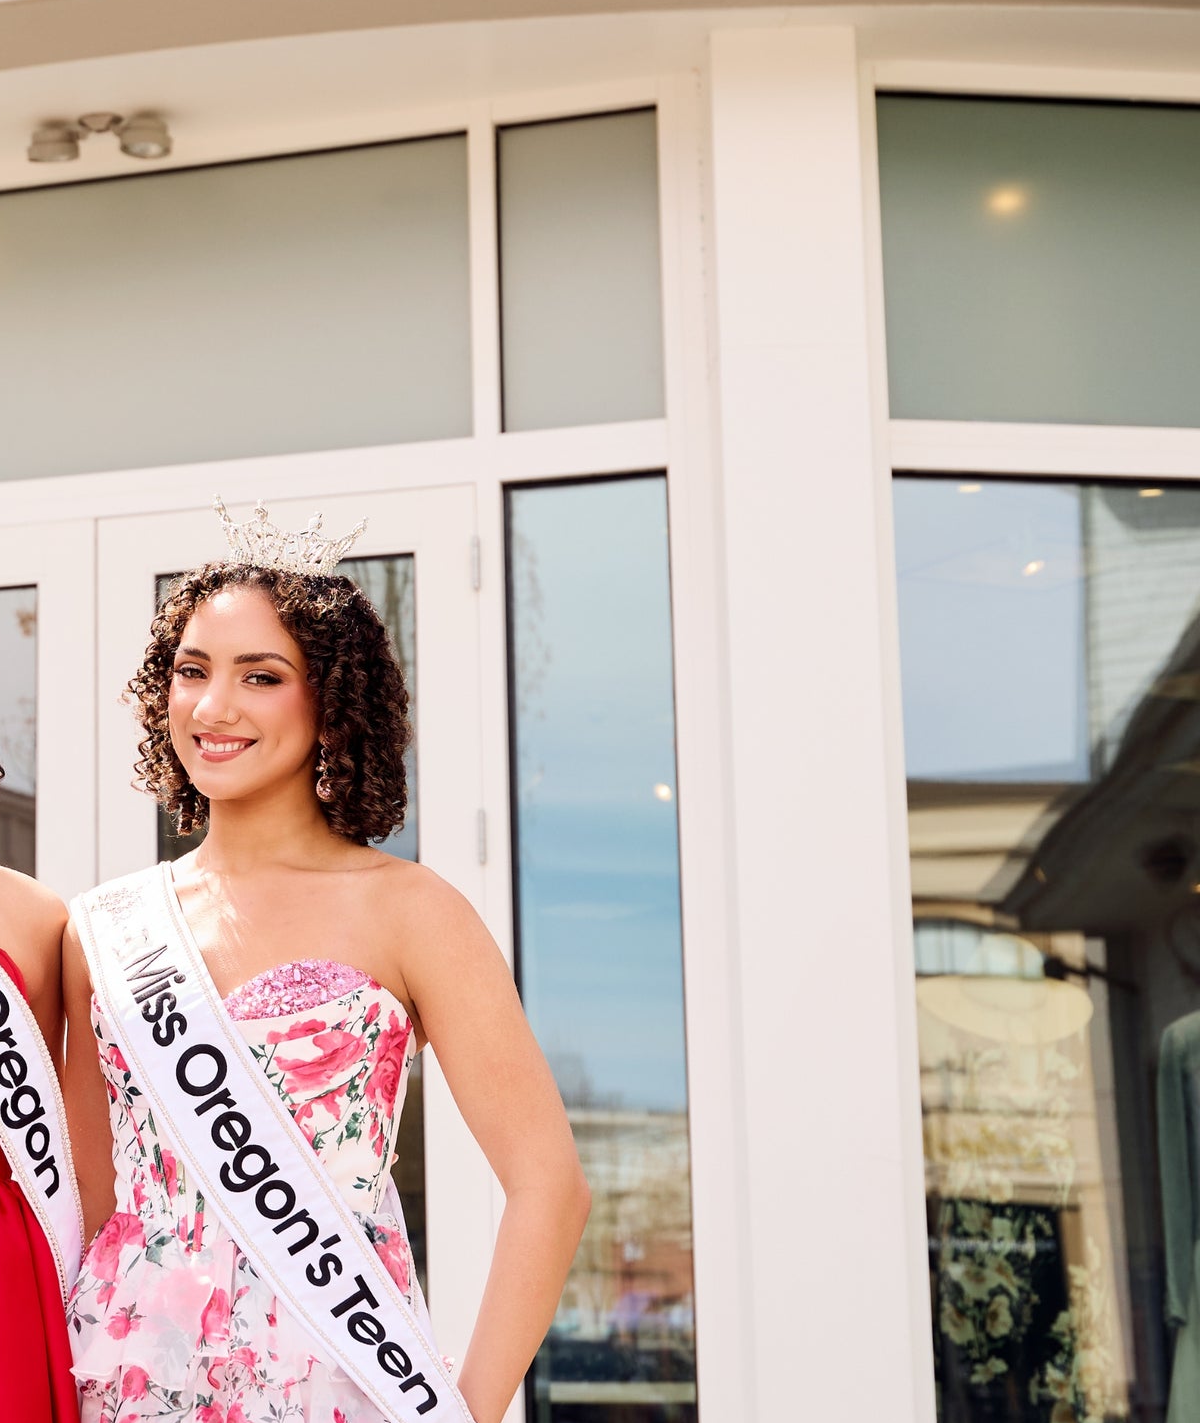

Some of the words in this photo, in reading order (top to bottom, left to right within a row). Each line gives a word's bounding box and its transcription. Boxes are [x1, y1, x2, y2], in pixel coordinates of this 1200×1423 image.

[123, 944, 188, 1048] Miss
[175, 1043, 343, 1287] Oregon's
[329, 1274, 439, 1415] Teen
